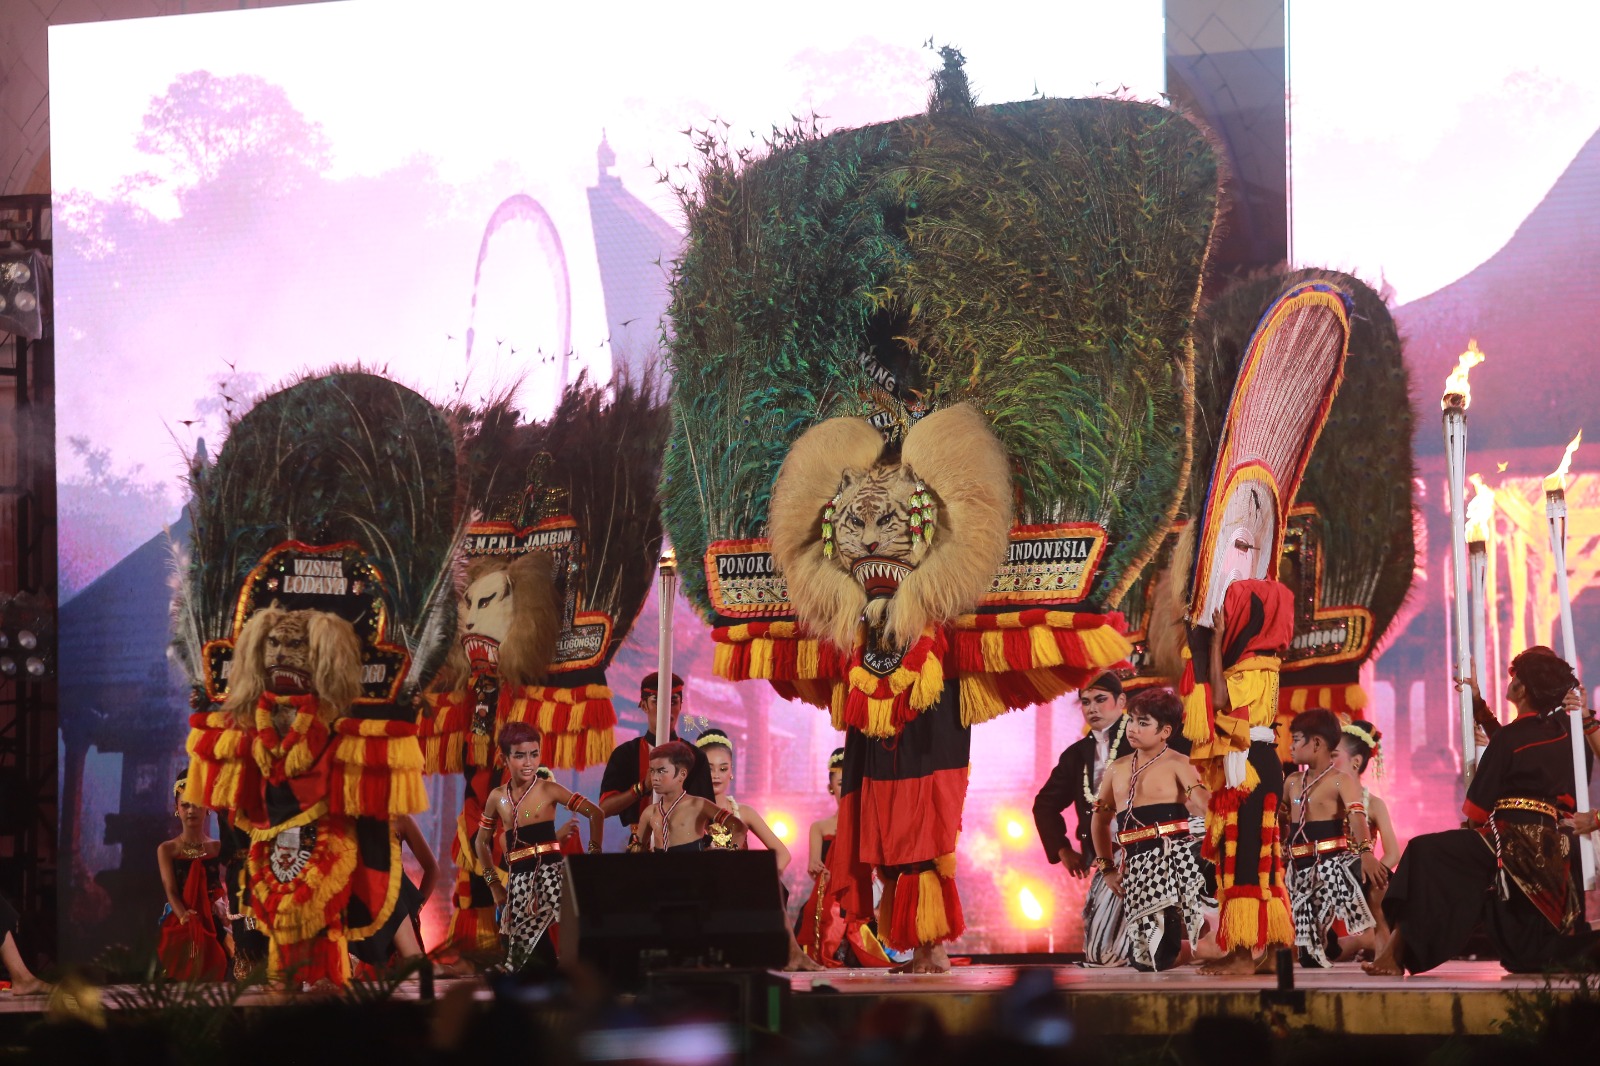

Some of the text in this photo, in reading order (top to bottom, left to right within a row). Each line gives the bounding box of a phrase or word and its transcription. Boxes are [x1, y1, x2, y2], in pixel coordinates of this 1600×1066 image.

[523, 529, 572, 547] JAMBON
[1009, 540, 1087, 562] INDONESIA
[294, 559, 344, 577] WISMA
[718, 555, 775, 575] PONORO
[283, 575, 348, 595] LODAYA
[1293, 628, 1347, 649] ONOROGO
[360, 664, 386, 683] OGO
